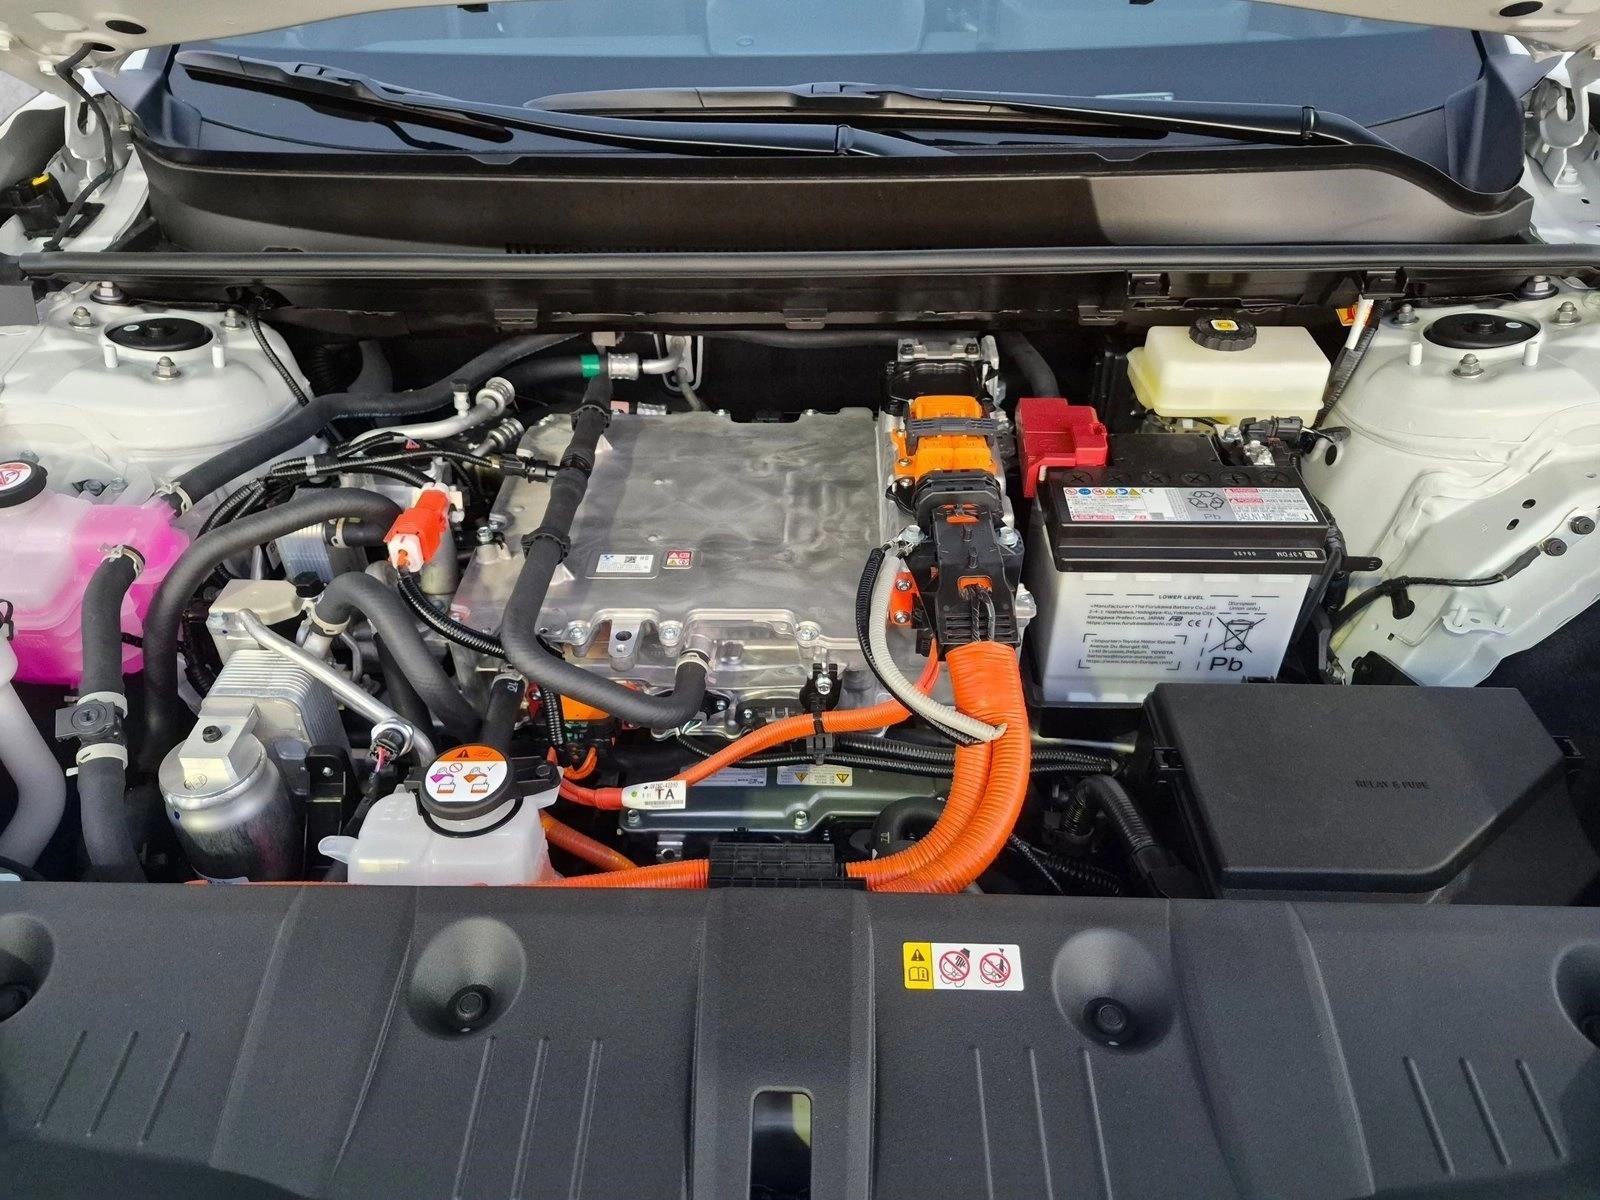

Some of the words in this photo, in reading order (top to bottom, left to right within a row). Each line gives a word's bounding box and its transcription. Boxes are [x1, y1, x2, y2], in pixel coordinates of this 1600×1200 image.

[1209, 657, 1243, 672] Pb
[1354, 780, 1389, 789] RELAY
[1401, 780, 1430, 790] FUSE
[654, 788, 675, 800] TA
